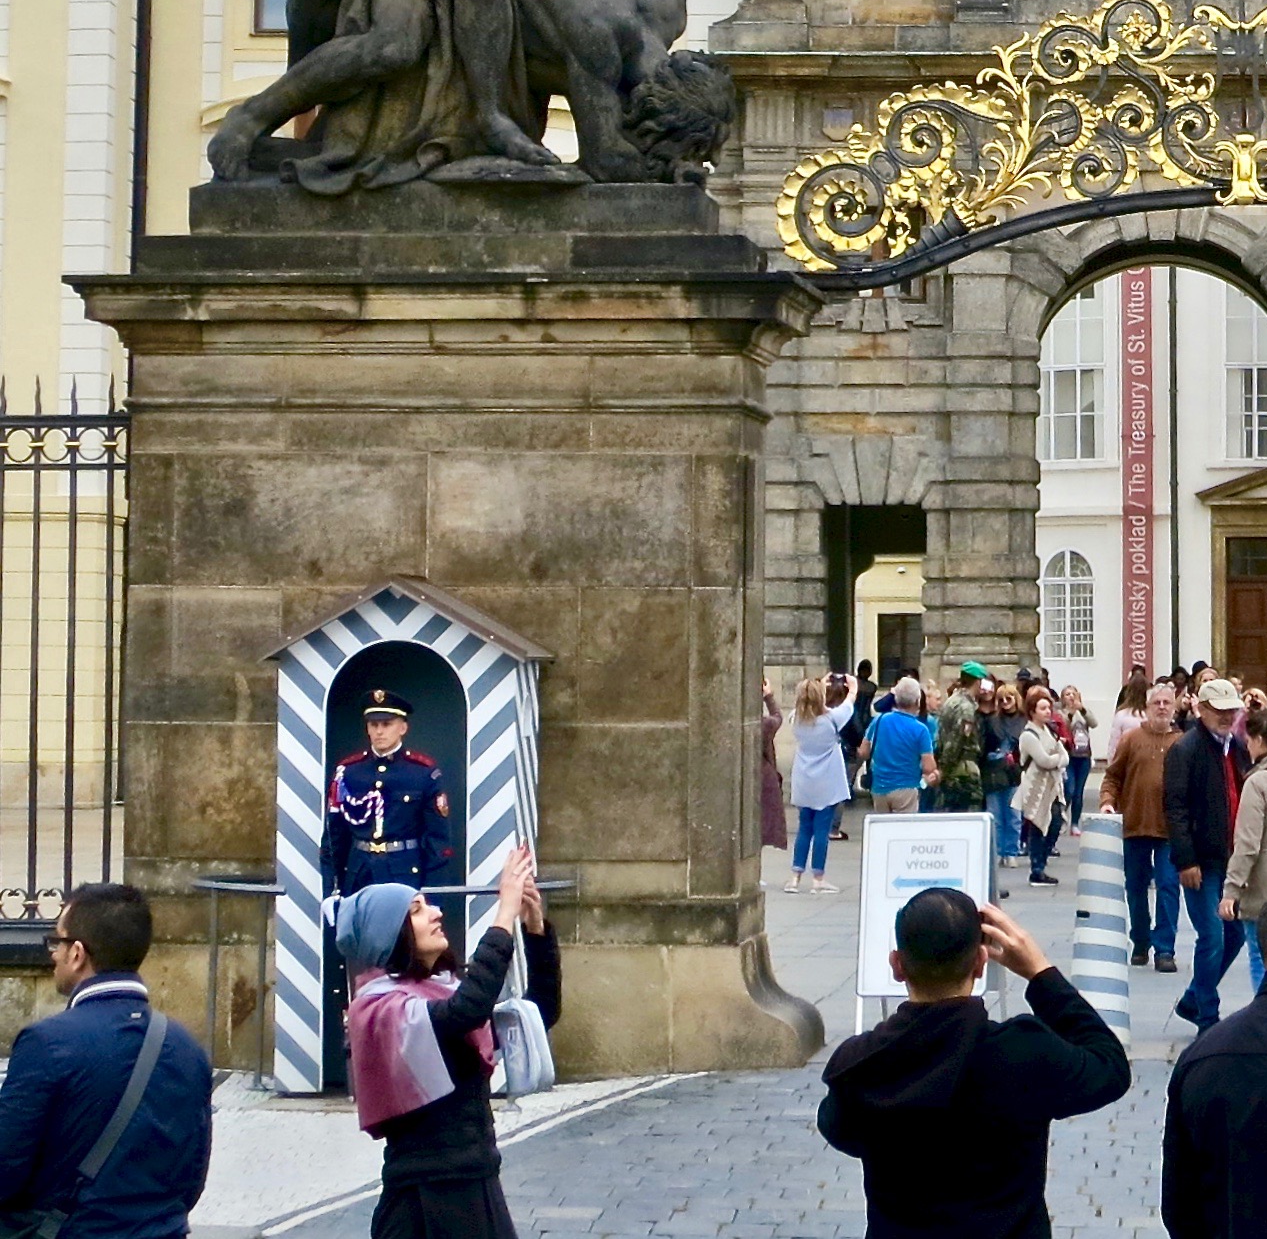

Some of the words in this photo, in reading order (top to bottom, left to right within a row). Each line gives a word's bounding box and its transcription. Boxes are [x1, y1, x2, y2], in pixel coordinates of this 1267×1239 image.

[1127, 280, 1145, 325] Vitus
[1127, 328, 1145, 353] St.
[1127, 359, 1145, 375] of
[1128, 381, 1149, 458] Treasury
[1128, 462, 1146, 497] The
[1128, 515, 1149, 575] poklad
[905, 857, 949, 870] VÝCHOD
[910, 844, 945, 855] POUZE
